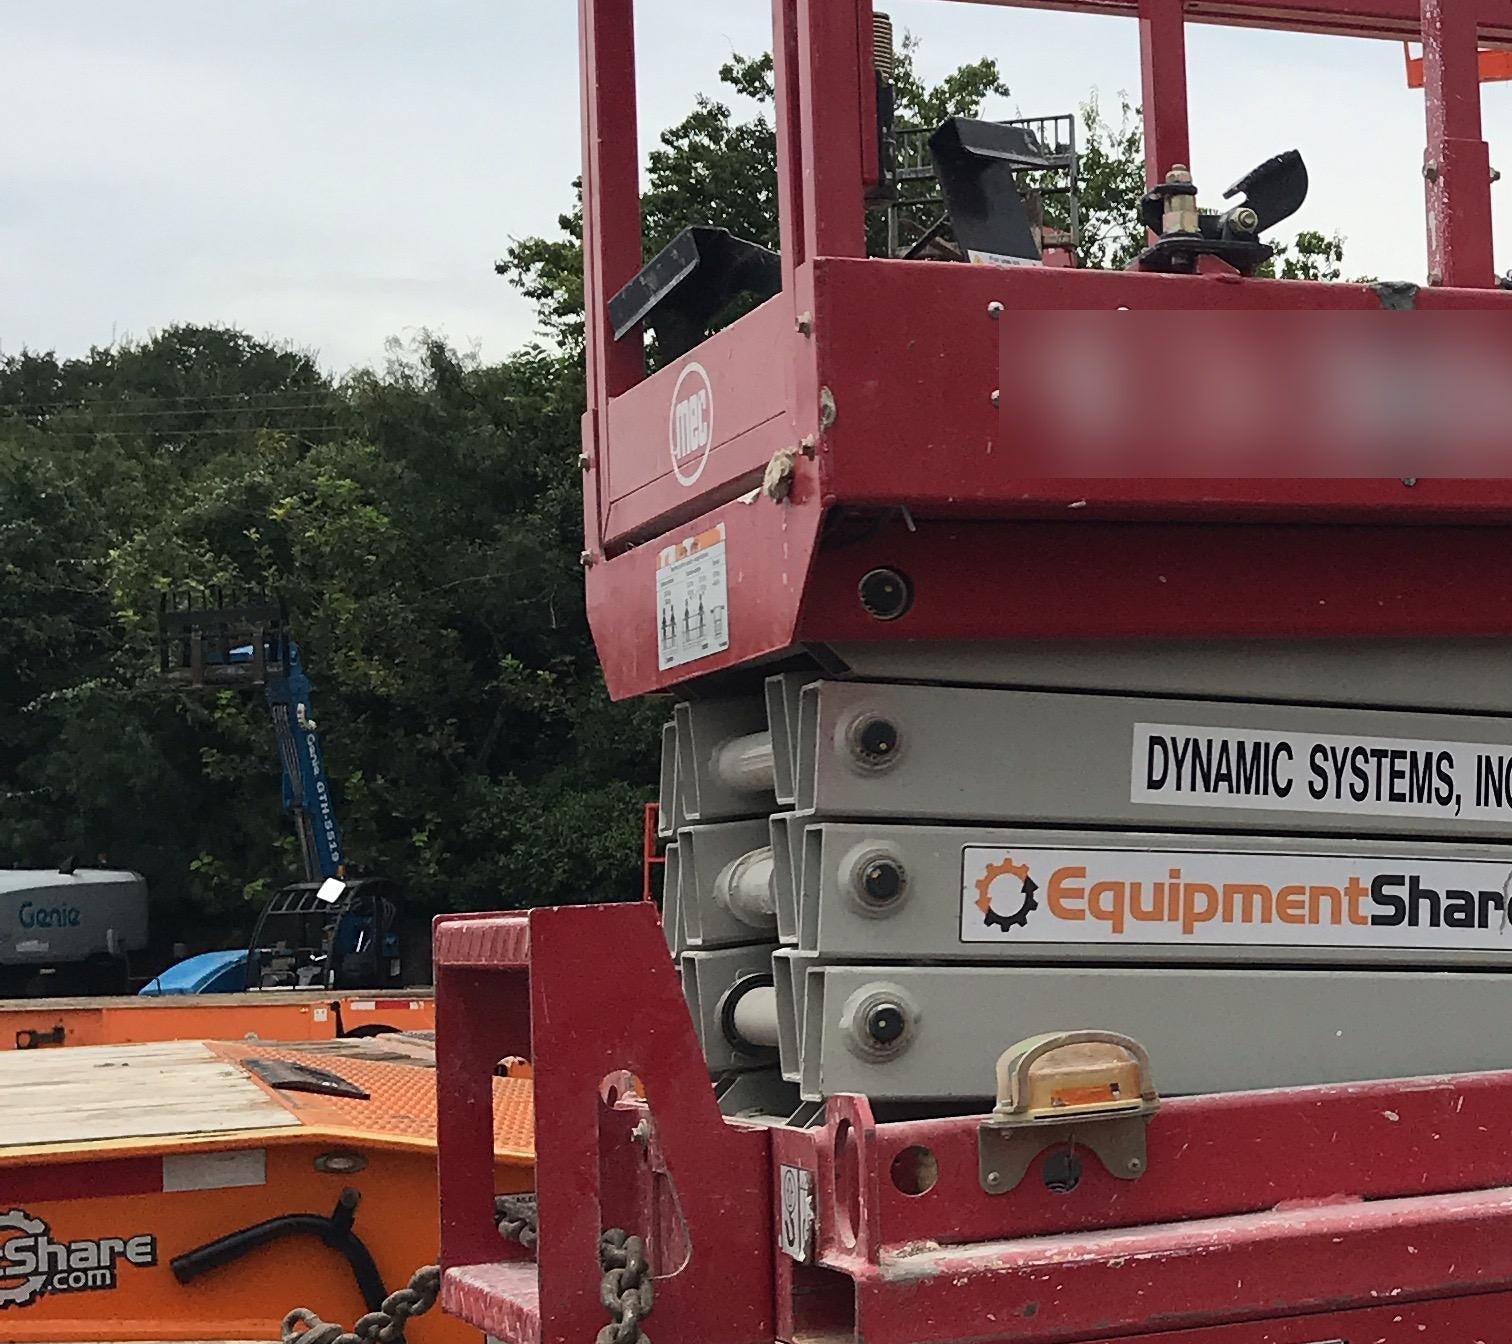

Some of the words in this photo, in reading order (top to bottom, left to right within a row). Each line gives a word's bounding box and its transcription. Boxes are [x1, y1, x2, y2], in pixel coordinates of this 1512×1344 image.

[1147, 735, 1294, 799] DYNAMIC
[1307, 746, 1462, 816] SYSTEMS,
[18, 901, 81, 929] Genie
[0, 1235, 155, 1277] Share
[48, 1269, 112, 1289] .com
